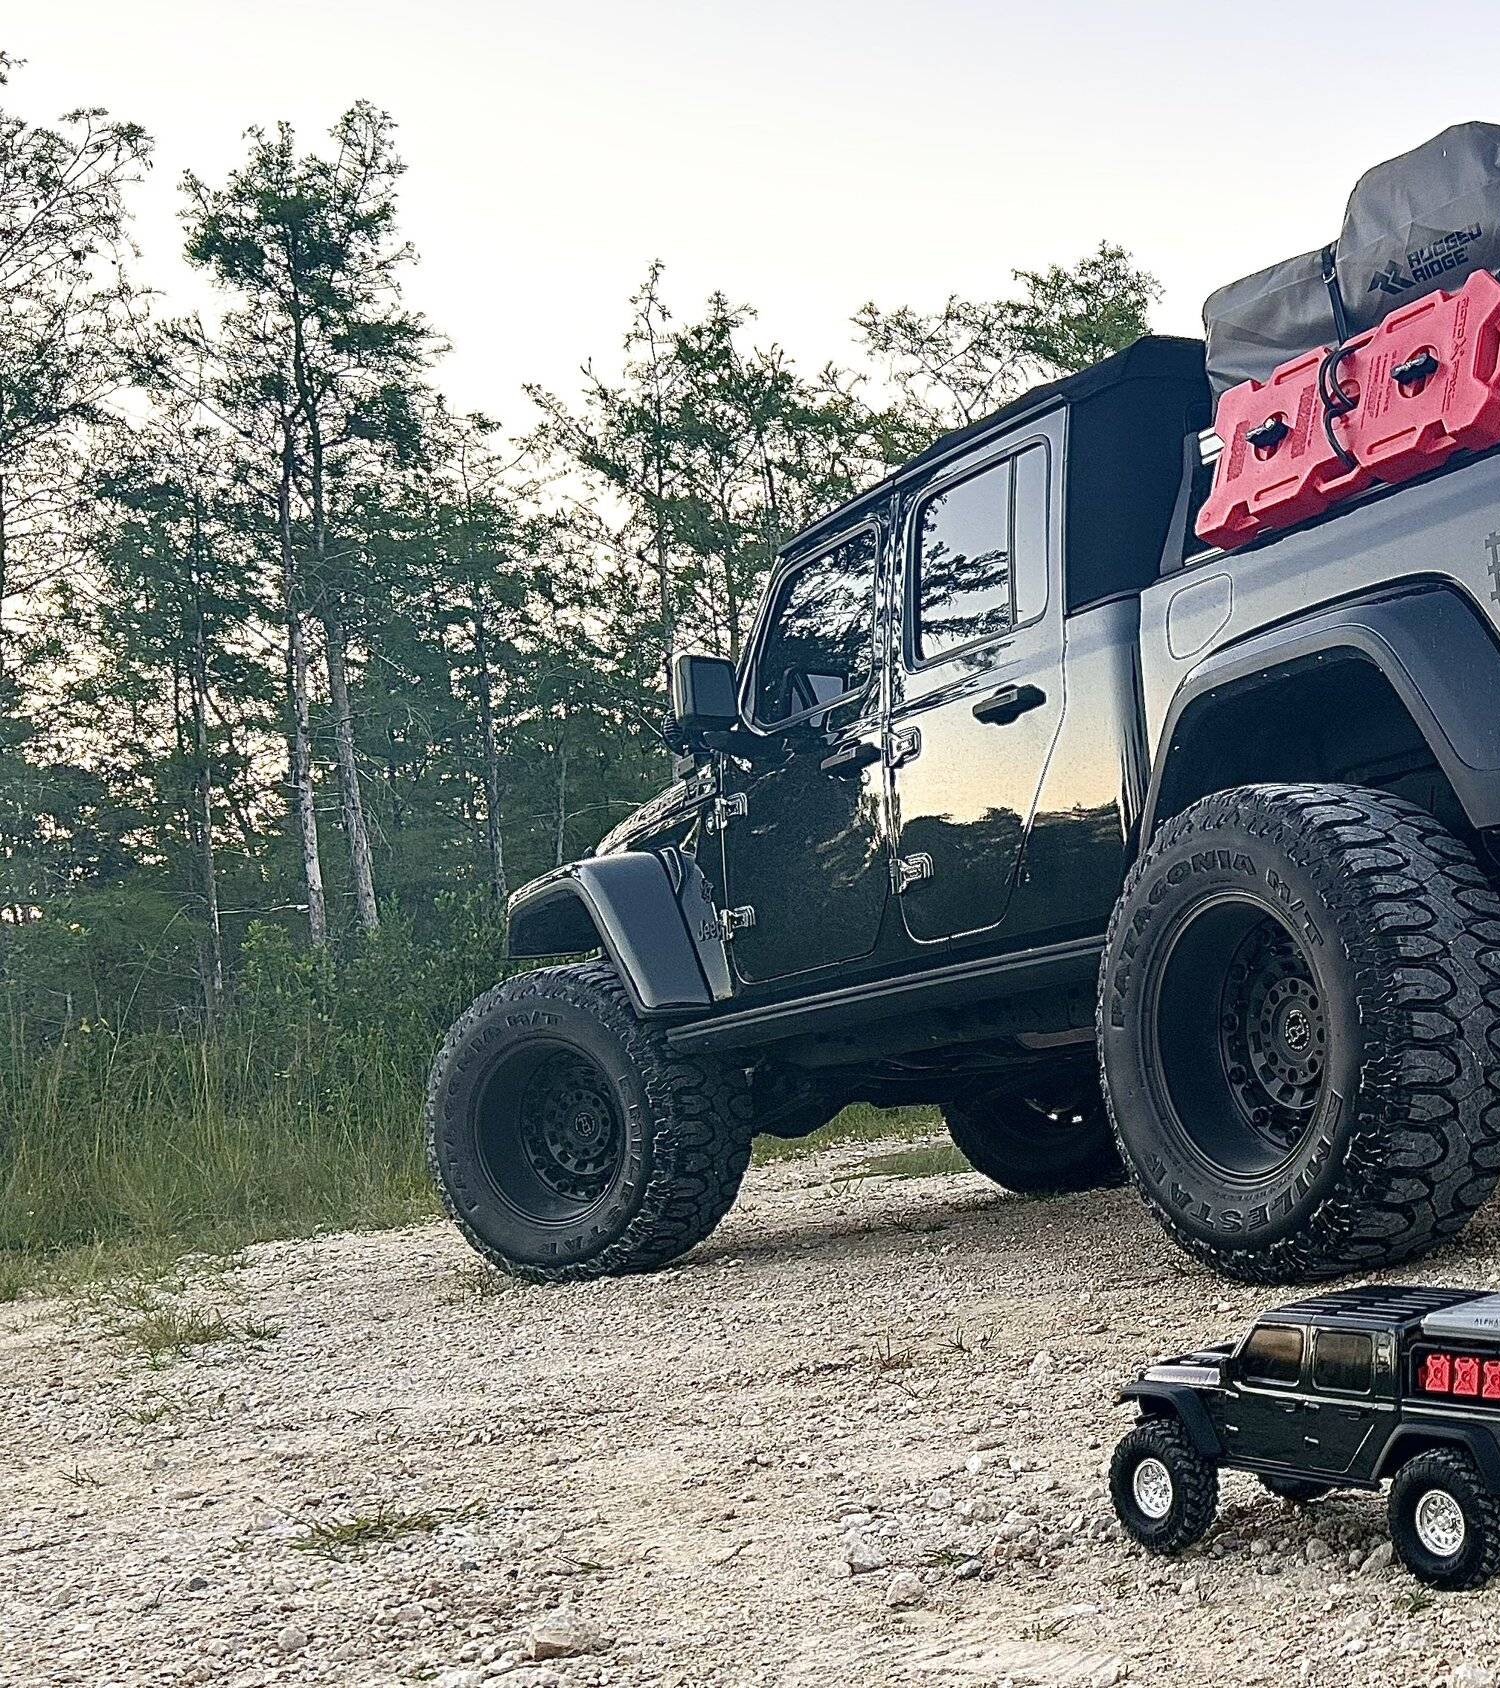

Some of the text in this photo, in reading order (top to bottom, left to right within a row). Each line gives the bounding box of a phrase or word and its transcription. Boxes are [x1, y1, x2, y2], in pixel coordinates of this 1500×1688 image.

[1406, 221, 1483, 269] RUGGED
[1411, 246, 1469, 284] RIDGE
[1110, 849, 1257, 1030] PATAGONIA
